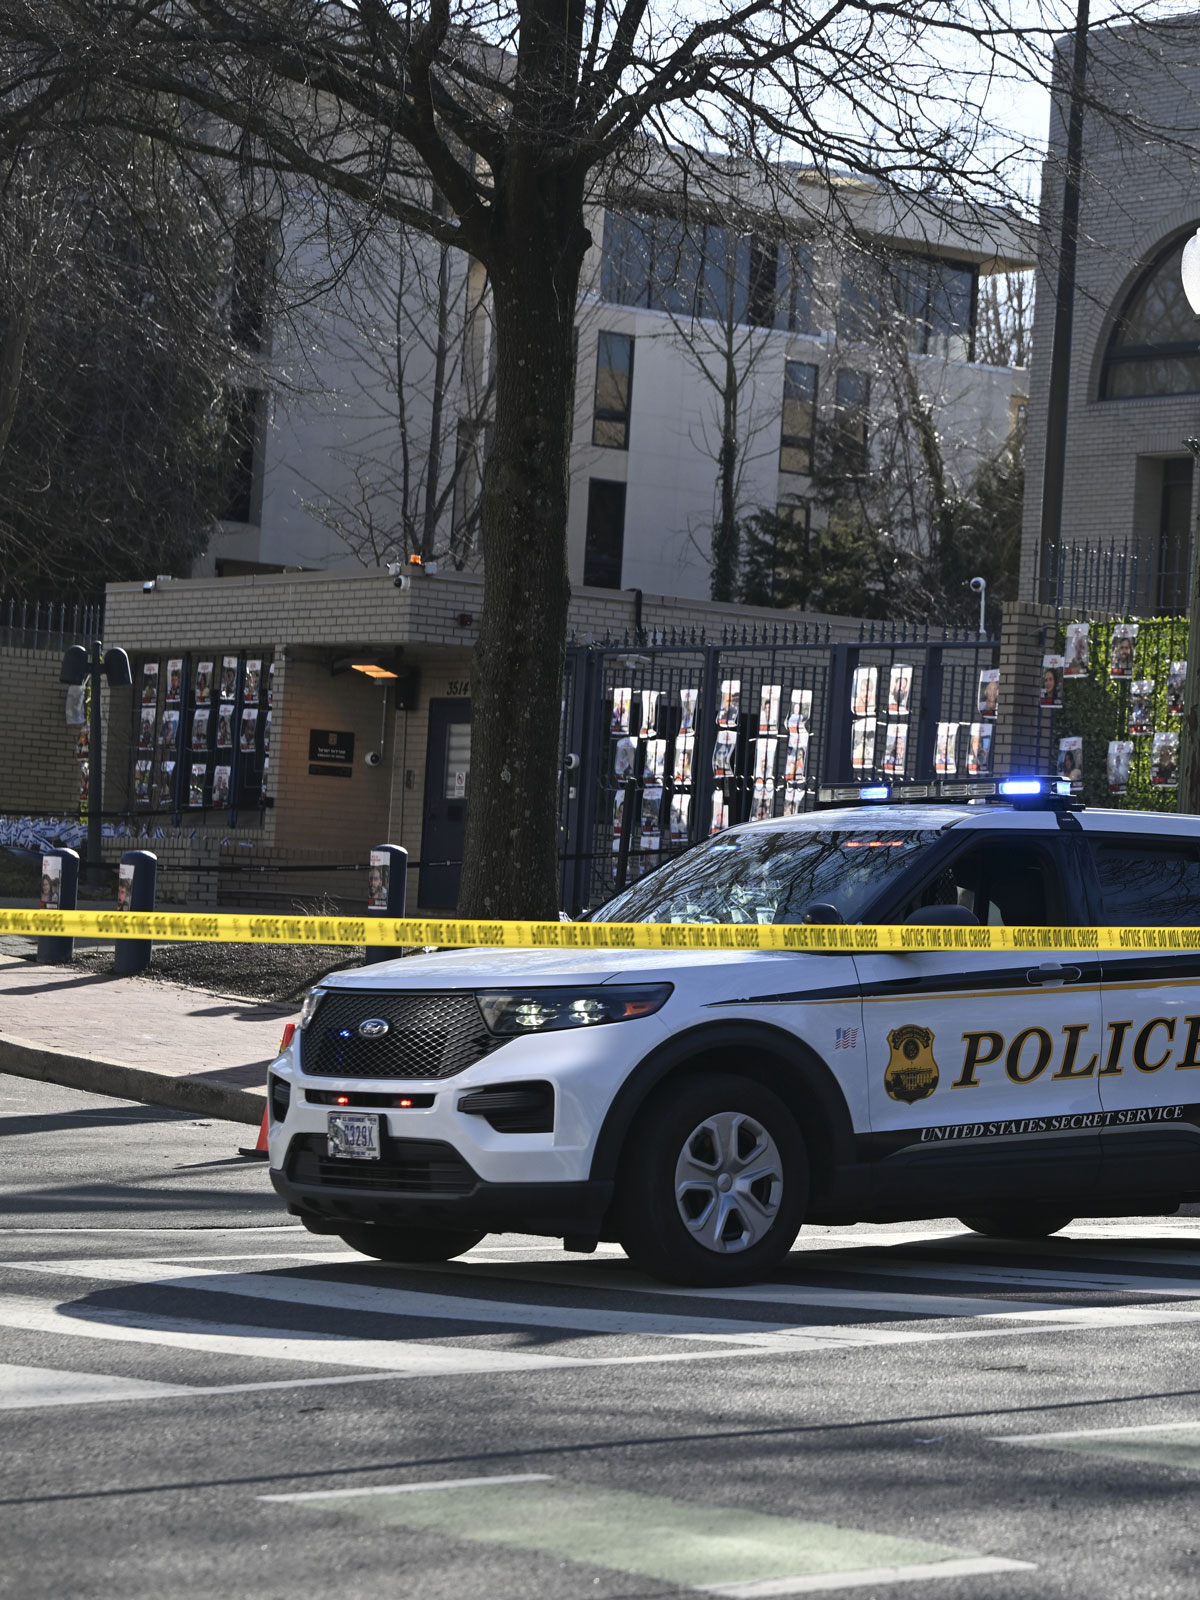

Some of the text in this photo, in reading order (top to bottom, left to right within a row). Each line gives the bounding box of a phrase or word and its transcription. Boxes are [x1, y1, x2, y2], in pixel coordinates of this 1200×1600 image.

[447, 680, 469, 695] 3514
[921, 1106, 1184, 1142] UNITED STATES SECRET SERVICE
